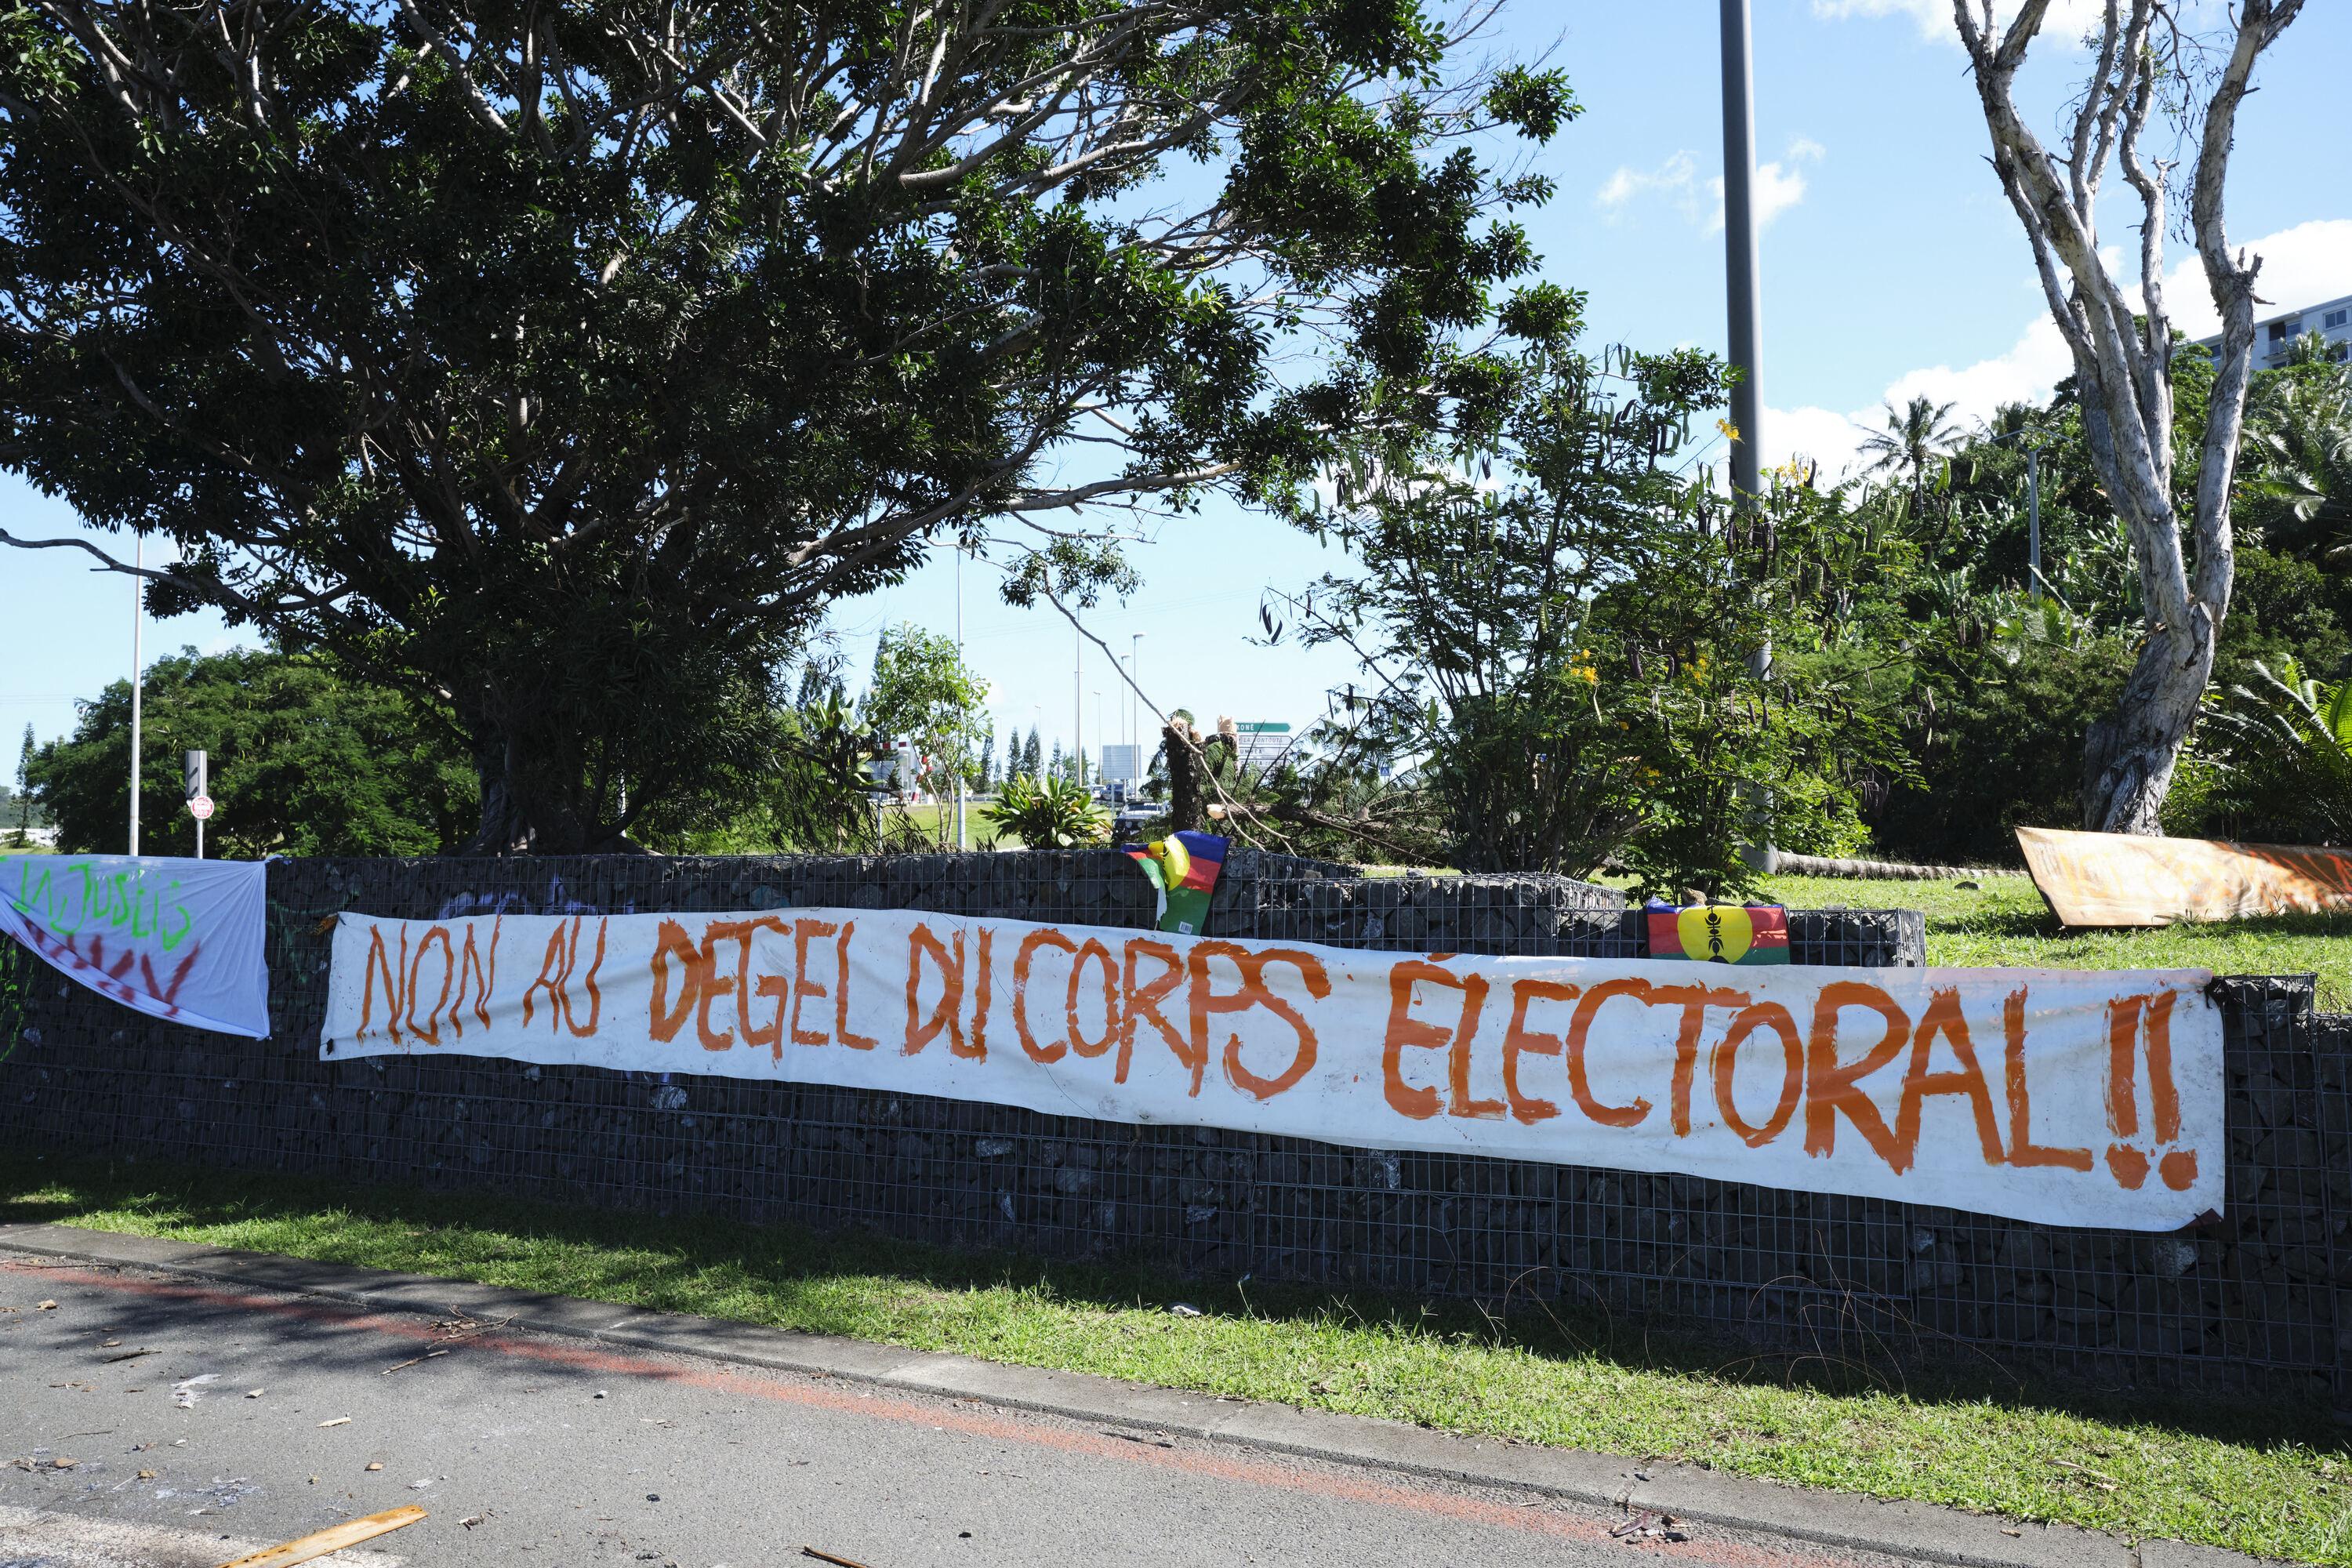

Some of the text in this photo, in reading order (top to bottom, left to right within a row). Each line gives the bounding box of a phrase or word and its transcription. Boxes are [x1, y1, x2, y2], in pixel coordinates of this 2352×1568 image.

[356, 915, 503, 1047] NON
[522, 916, 608, 1038] AU
[900, 921, 994, 1065] DU
[1012, 927, 1331, 1101] CORPS
